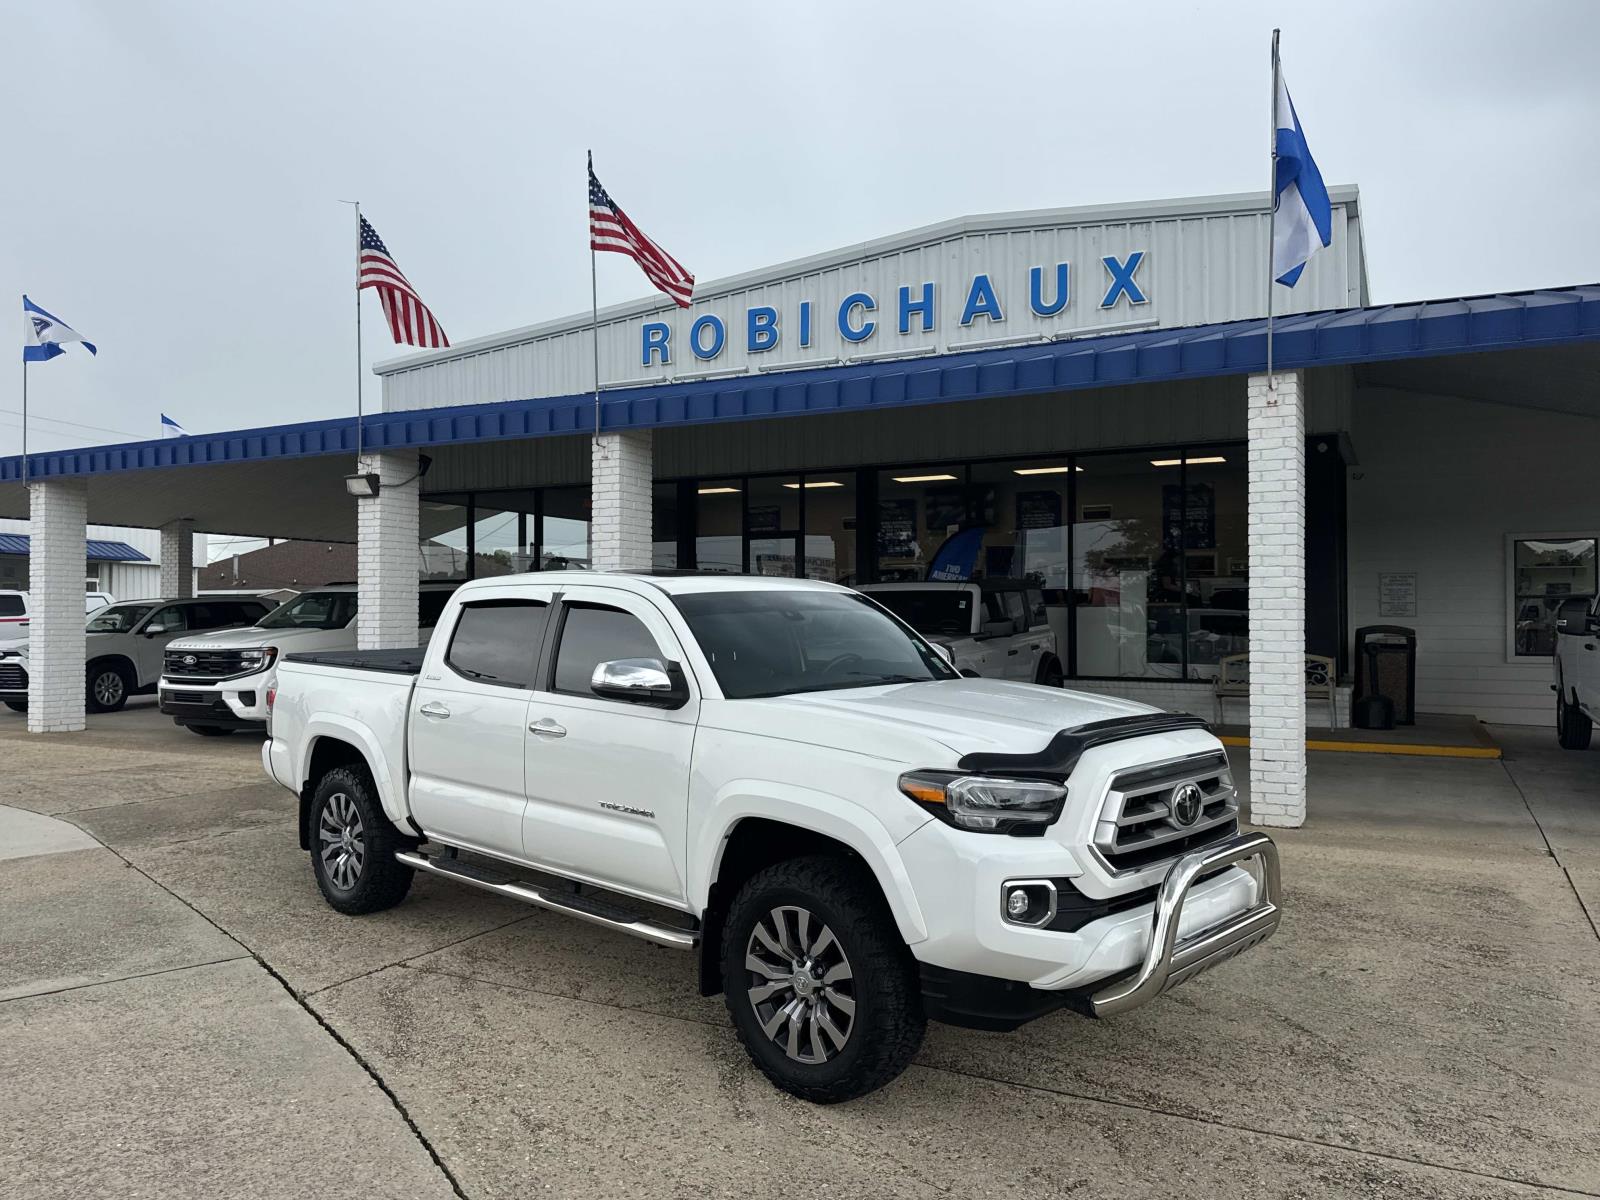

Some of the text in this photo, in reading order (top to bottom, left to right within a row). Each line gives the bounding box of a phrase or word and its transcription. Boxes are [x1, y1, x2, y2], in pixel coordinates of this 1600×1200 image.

[641, 250, 1149, 367] ROBICHAUX
[945, 563, 961, 574] TWO
[931, 570, 968, 581] AMERICAN
